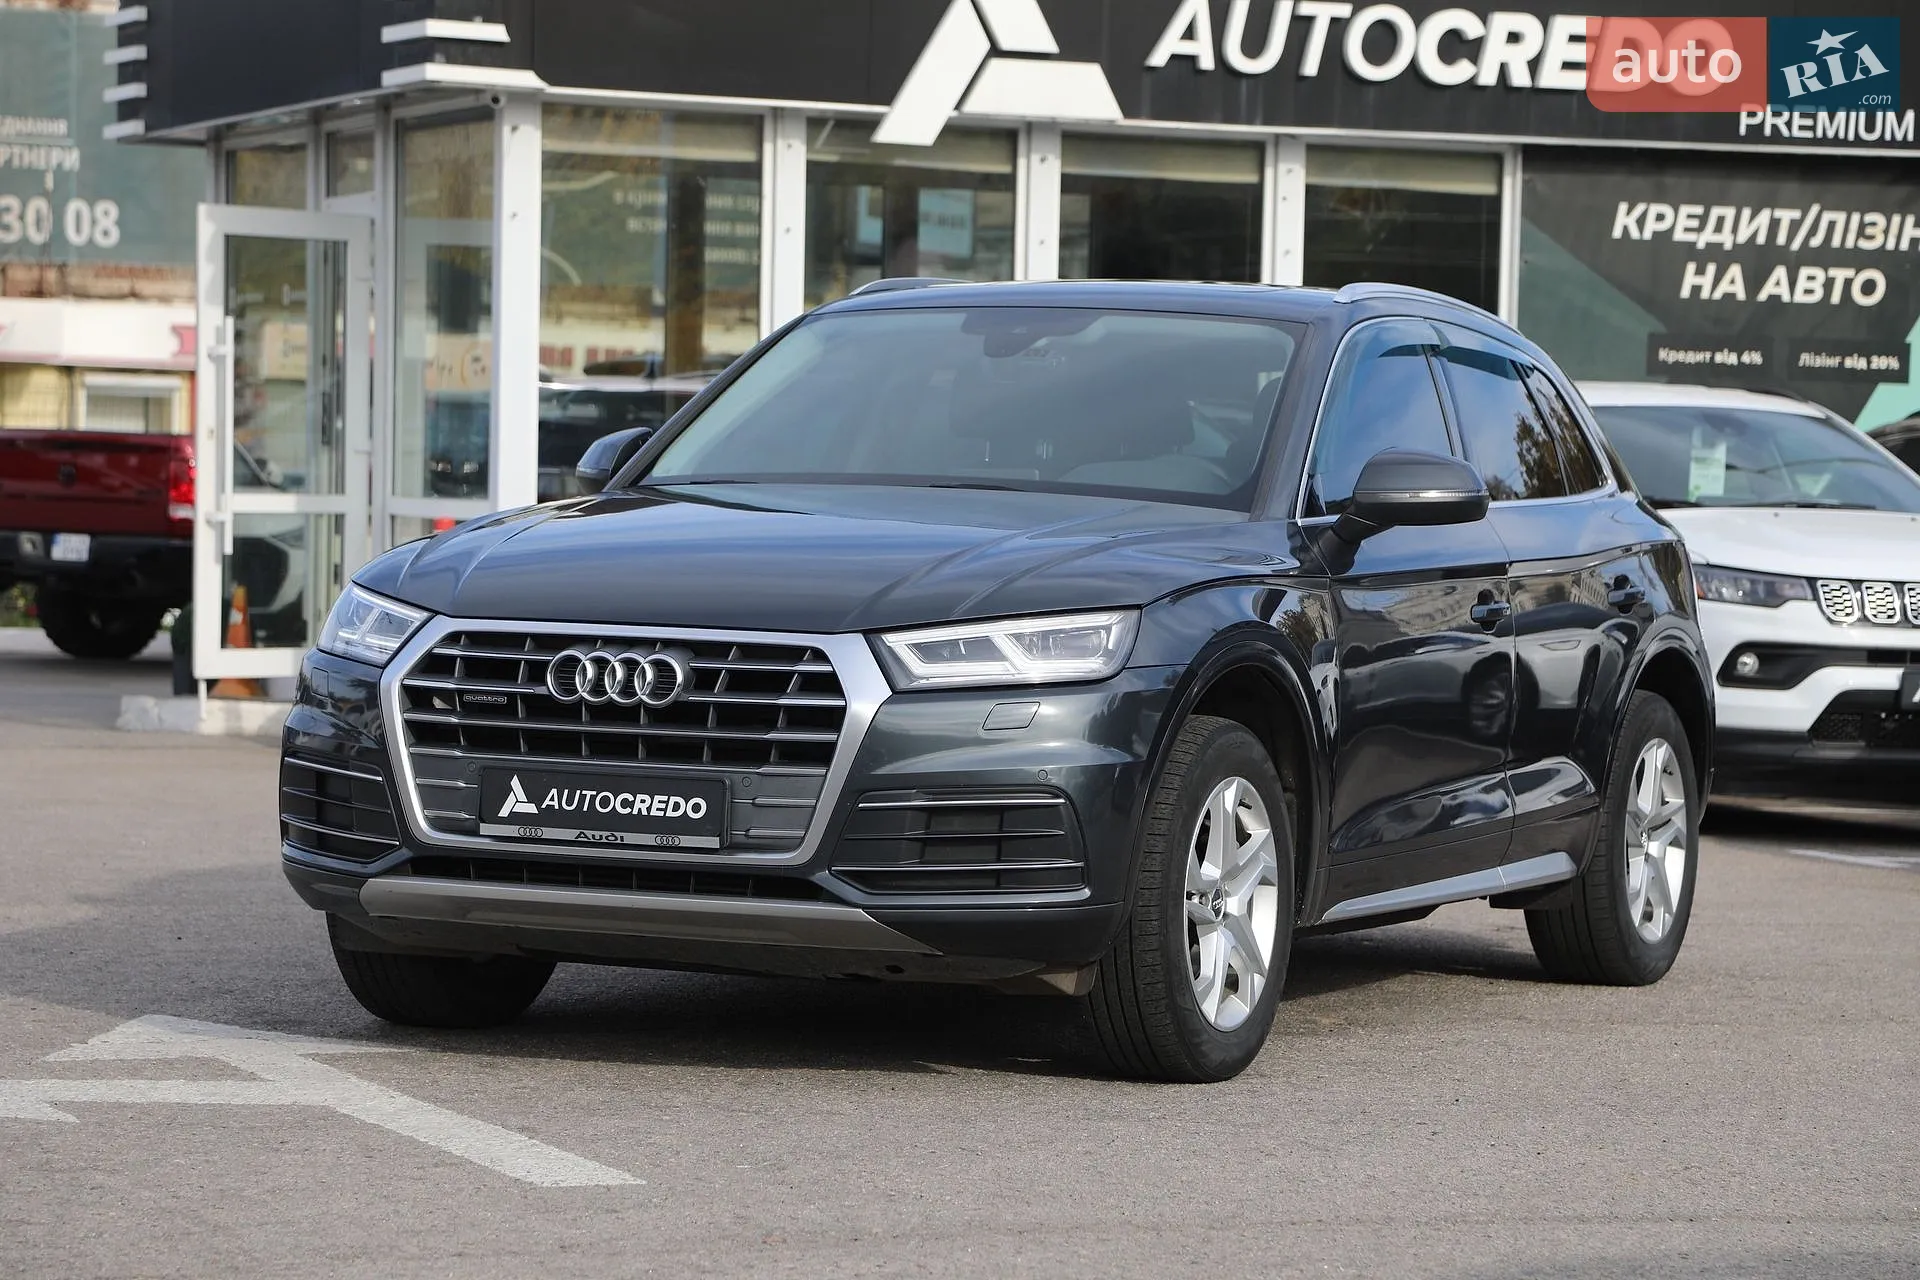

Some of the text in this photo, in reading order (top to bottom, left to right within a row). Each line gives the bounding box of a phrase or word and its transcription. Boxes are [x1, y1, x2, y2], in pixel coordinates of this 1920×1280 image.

[1144, 0, 1735, 96] AUTOCREDO
[1739, 103, 1915, 142] PREMIUM
[64, 197, 120, 248] 08
[1679, 261, 1887, 307] НА АВТО
[1658, 347, 1763, 366] Кредит від 4%
[541, 788, 707, 820] AUTOCREDO
[574, 831, 624, 843] Audi
